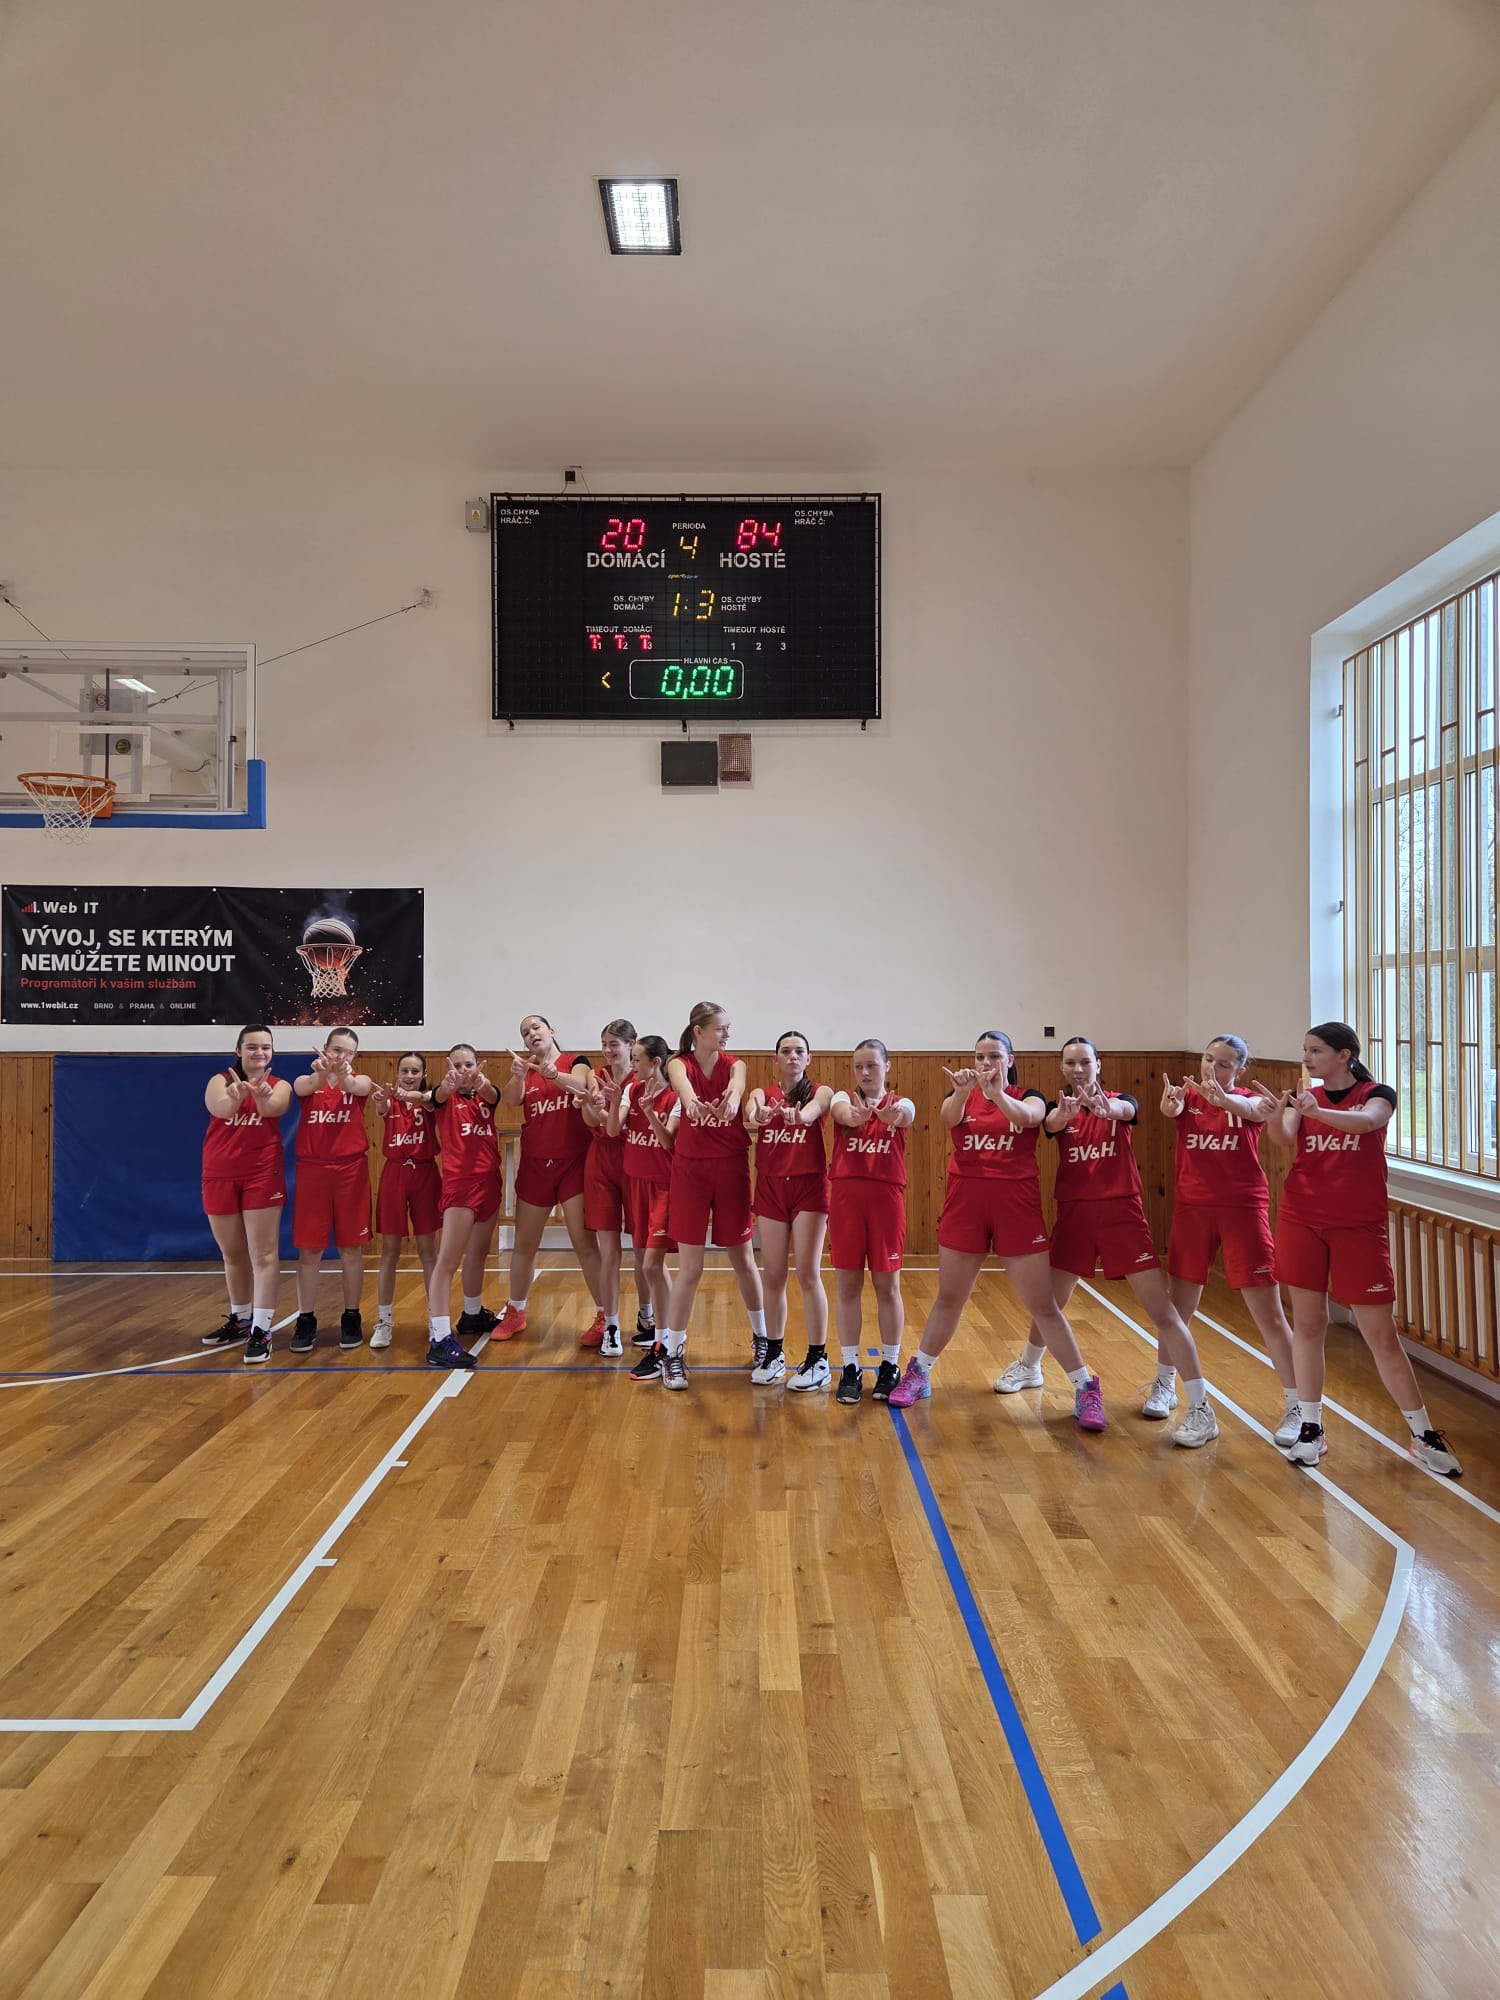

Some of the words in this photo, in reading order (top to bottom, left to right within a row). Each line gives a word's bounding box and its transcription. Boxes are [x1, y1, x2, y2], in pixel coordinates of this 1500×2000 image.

[672, 522, 706, 530] PERIODA
[601, 518, 647, 549] 20
[737, 519, 782, 549] 84
[680, 535, 698, 560] 4
[586, 549, 666, 568] DOMÁCÍ
[719, 549, 786, 568] HOSTÉ
[613, 603, 644, 611] DOMÁCÍ
[721, 603, 747, 611] HOSTÉ
[623, 625, 653, 633] DOMÁCÍ
[760, 625, 786, 633] HOSTÉ
[730, 642, 736, 650] 1
[755, 642, 762, 650] 2
[780, 642, 787, 650] 3
[683, 656, 711, 664] HLAVNÍ
[712, 656, 729, 664] ČAS
[43, 901, 78, 914] Web
[84, 902, 99, 914] IT
[21, 924, 101, 950] VÝVOJ,
[108, 929, 136, 947] SE
[141, 925, 233, 947] KTERÝM
[21, 949, 141, 972] NEMŮŽETE
[147, 954, 235, 972] MINOUT
[20, 977, 97, 990] Programátoři
[100, 978, 107, 988] k
[110, 978, 145, 989] vašim
[148, 978, 196, 989] službám
[20, 1001, 79, 1009] www.1webit.cz
[413, 1108, 424, 1126] 5
[479, 1102, 491, 1120] 6
